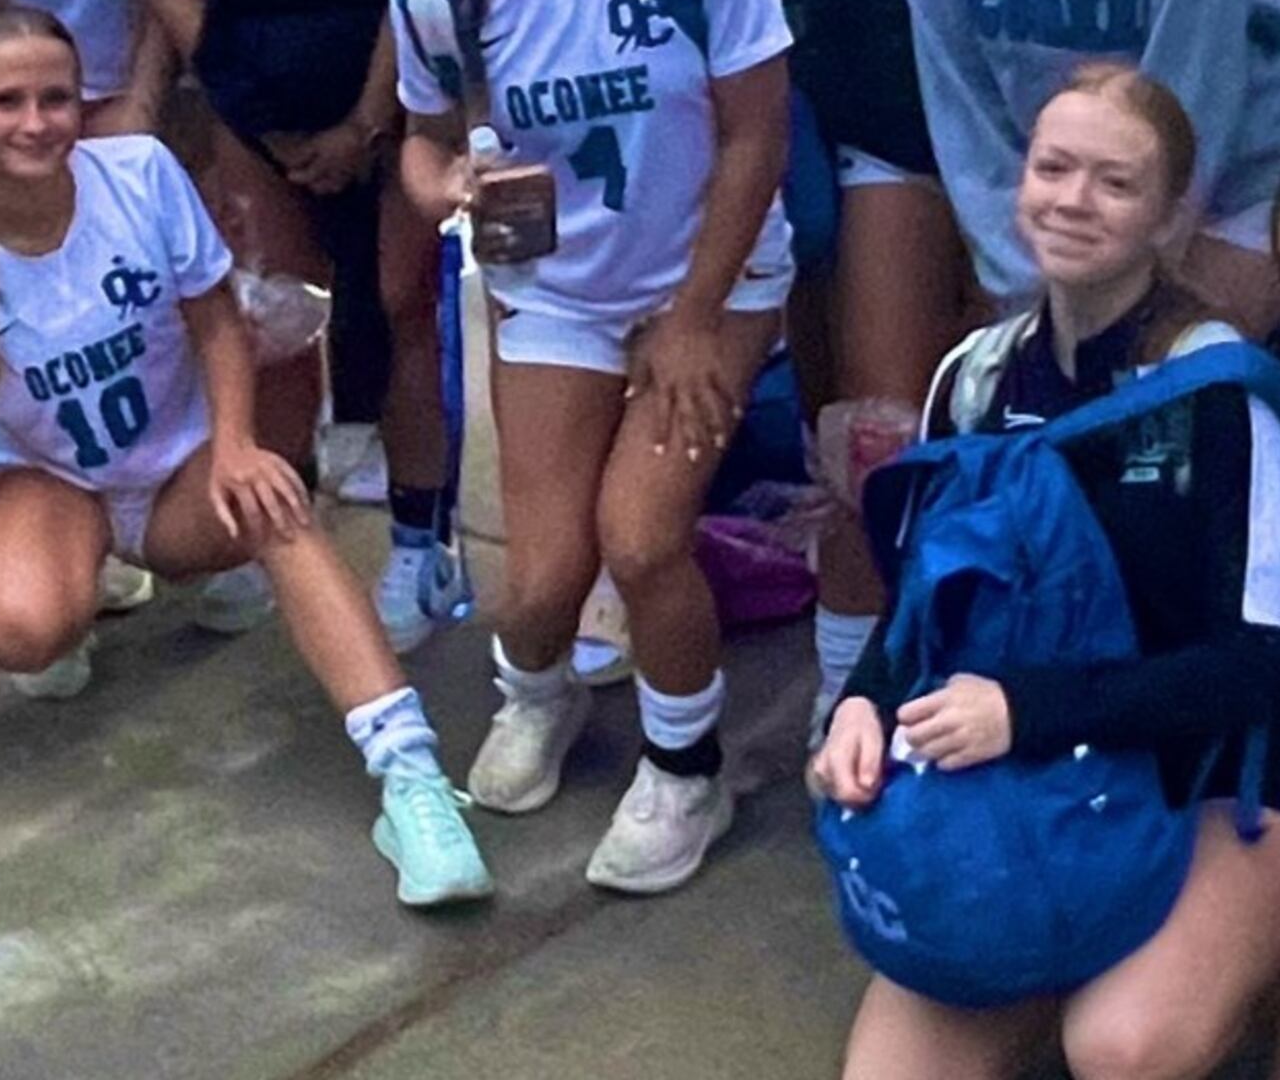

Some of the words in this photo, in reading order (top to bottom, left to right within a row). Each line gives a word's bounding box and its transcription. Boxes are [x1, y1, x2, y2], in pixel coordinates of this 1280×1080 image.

[506, 65, 655, 129] OCONEE
[568, 125, 627, 213] 4
[24, 322, 147, 402] OCONEE
[57, 376, 150, 468] 10
